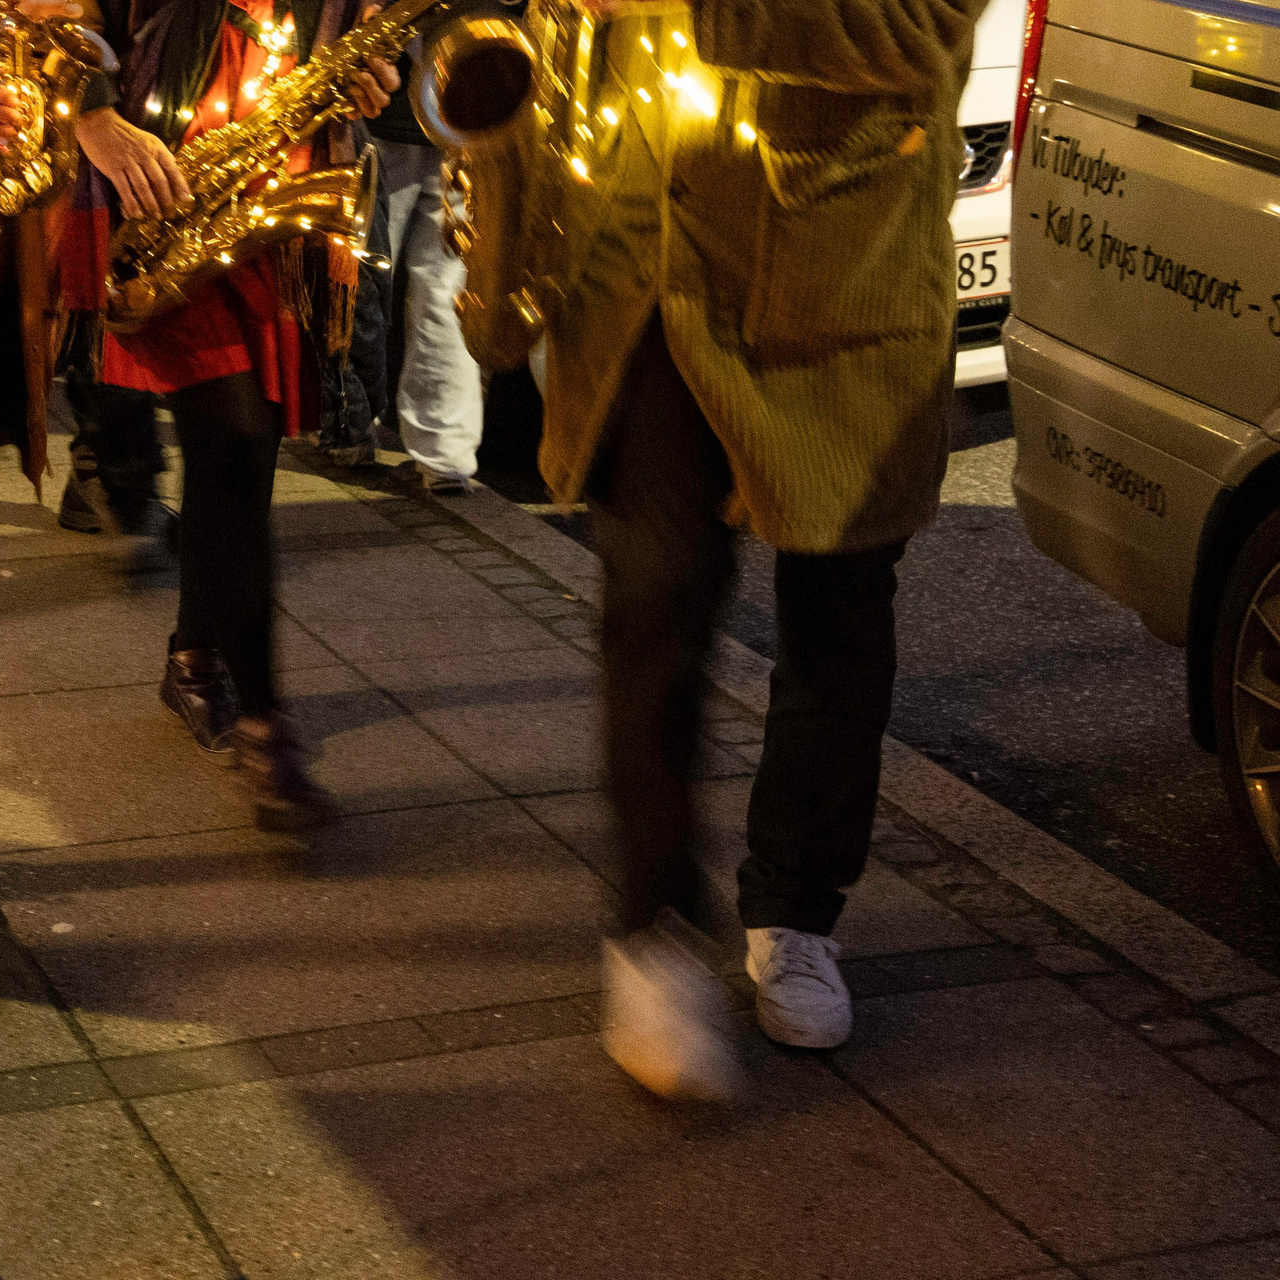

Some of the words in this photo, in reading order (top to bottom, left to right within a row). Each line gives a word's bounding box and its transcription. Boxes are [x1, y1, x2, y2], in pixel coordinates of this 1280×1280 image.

[958, 250, 997, 291] 85
[1077, 214, 1094, 257] &
[1099, 220, 1138, 281] frys
[1144, 245, 1242, 318] transport
